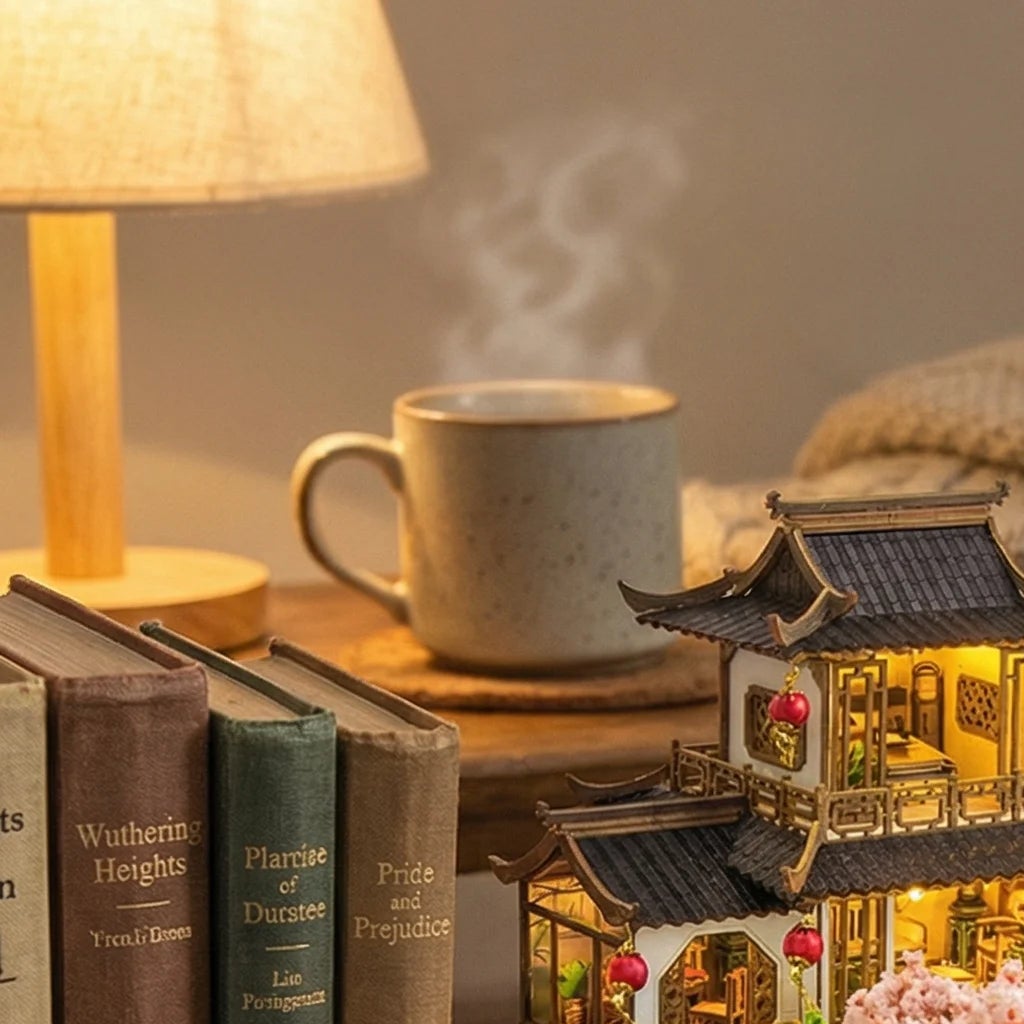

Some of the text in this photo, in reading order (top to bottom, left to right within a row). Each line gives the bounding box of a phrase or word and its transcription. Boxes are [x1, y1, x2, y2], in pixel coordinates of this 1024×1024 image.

[76, 815, 201, 849] Wuthering
[94, 853, 188, 887] Heights
[377, 862, 435, 886] Pride
[390, 891, 422, 910] and
[353, 915, 451, 945] Prejudice
